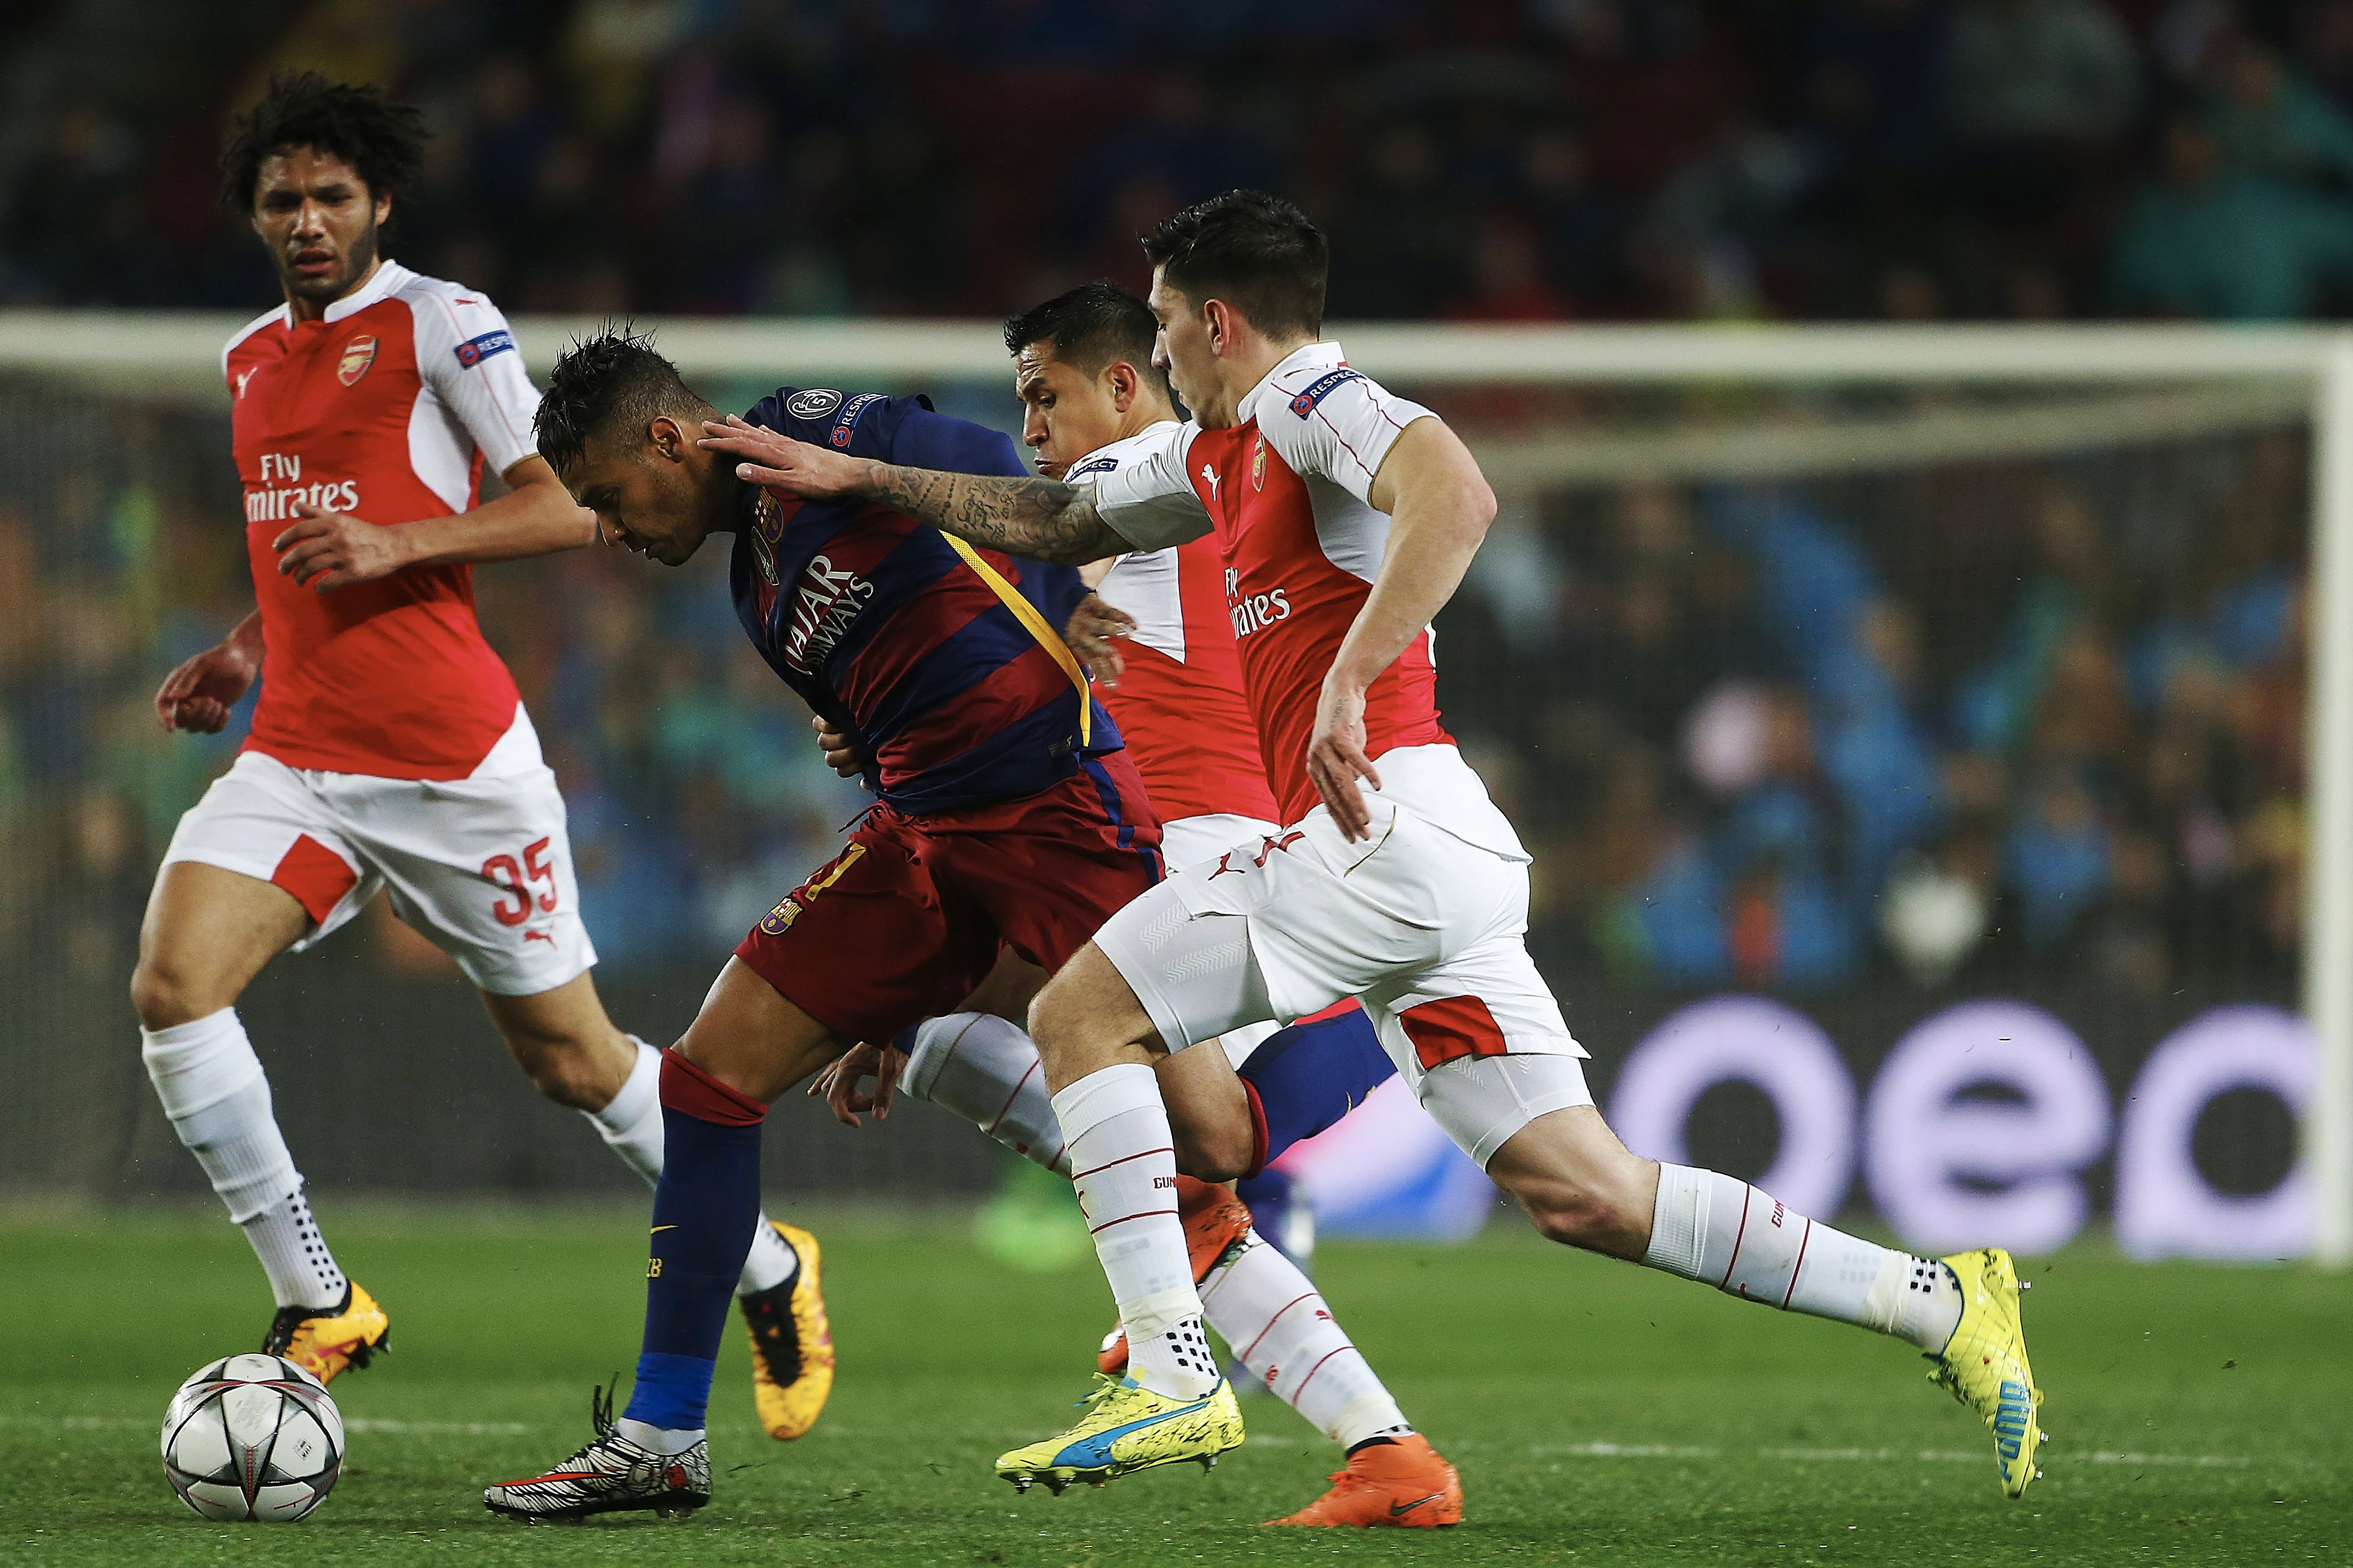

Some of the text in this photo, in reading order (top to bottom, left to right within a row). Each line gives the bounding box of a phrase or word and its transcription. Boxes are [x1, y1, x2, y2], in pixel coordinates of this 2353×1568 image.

[1309, 371, 1360, 398] RESPEC
[260, 453, 301, 482] Fly
[245, 480, 359, 522] mirates
[1224, 567, 1238, 598] Fly
[1229, 588, 1291, 641] irates
[481, 836, 557, 927] 35
